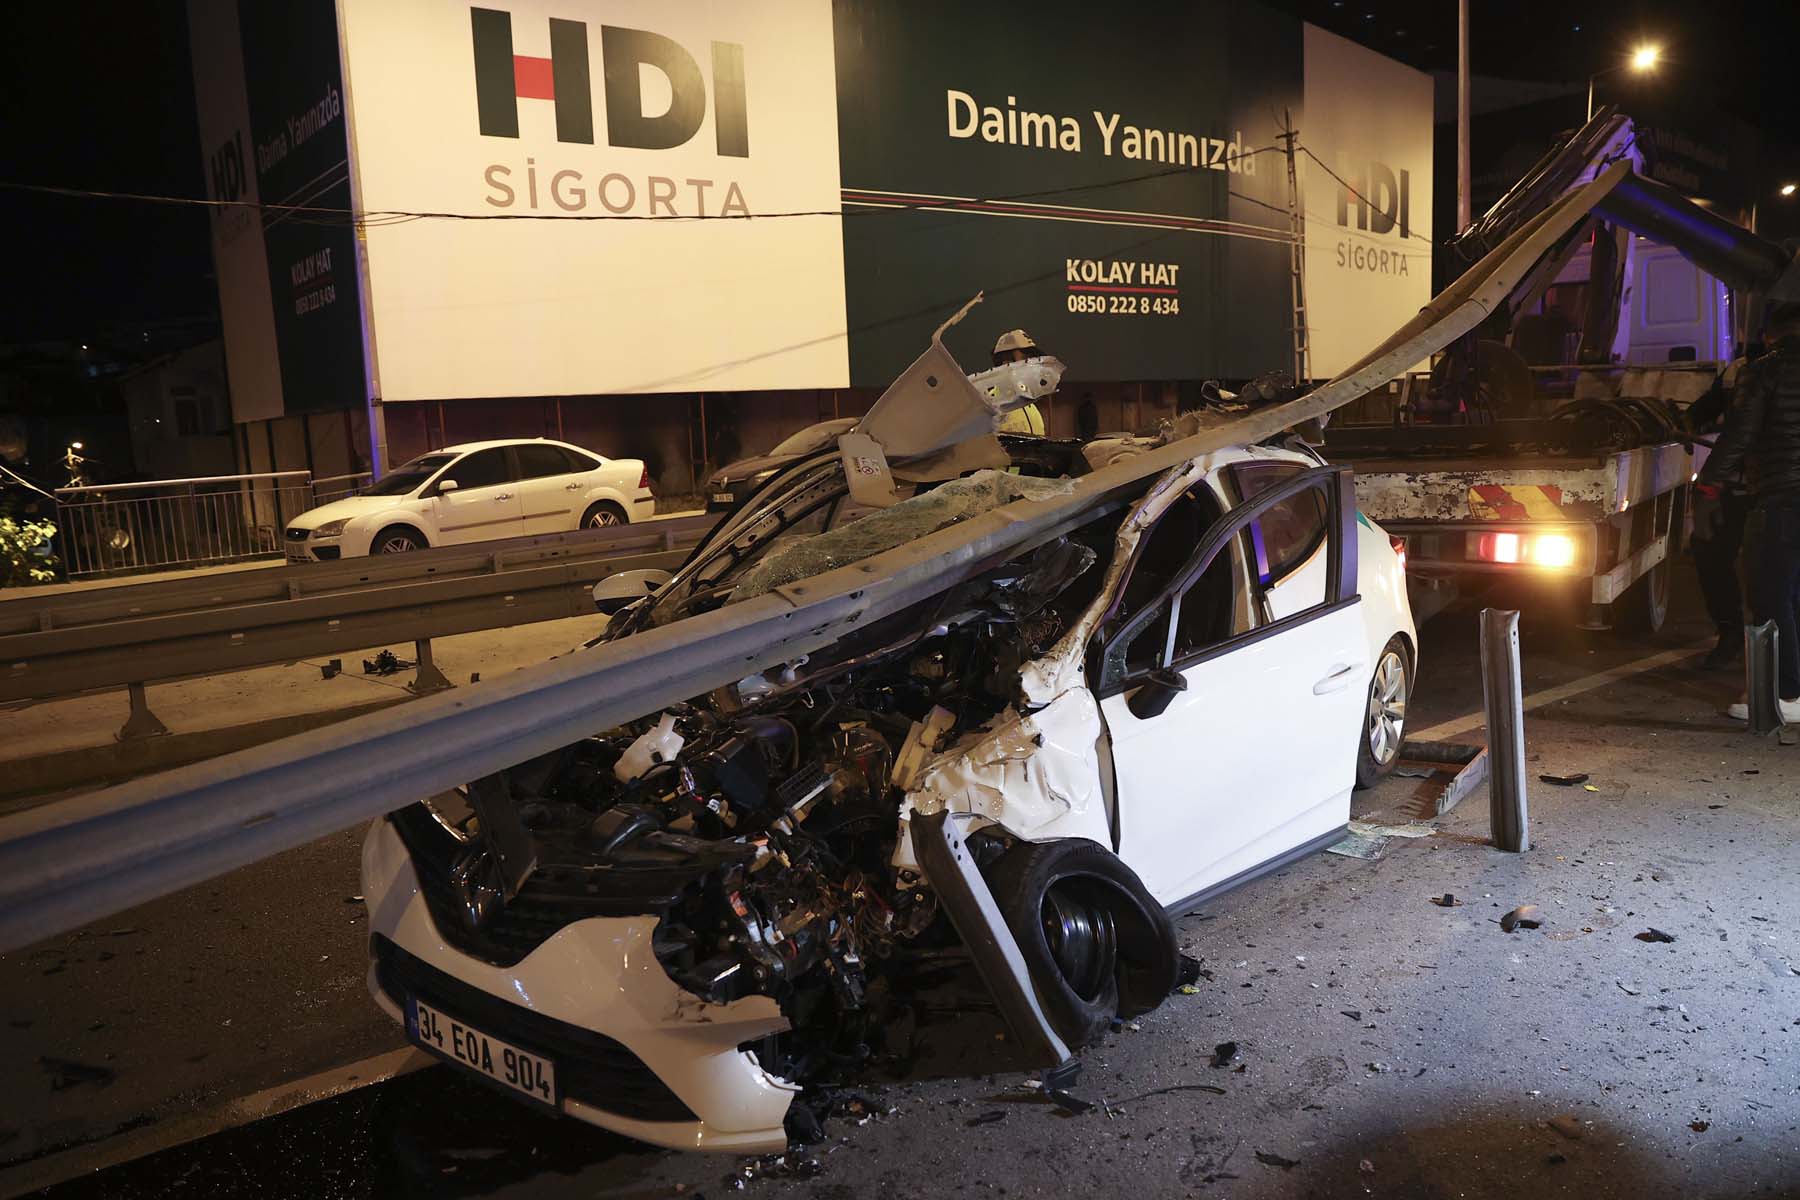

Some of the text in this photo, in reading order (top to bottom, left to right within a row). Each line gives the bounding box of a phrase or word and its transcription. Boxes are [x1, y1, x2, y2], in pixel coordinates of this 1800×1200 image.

[470, 6, 749, 158] HDI
[947, 89, 1256, 176] Daima Yanınızda
[484, 158, 752, 220] SİGORTA
[1337, 152, 1409, 239] HDI
[1066, 259, 1179, 286] KOLAY HAT
[1337, 237, 1409, 277] SİGORTA
[1067, 295, 1179, 315] 0850 222 8 434
[419, 1006, 550, 1099] 34 EOA 904
